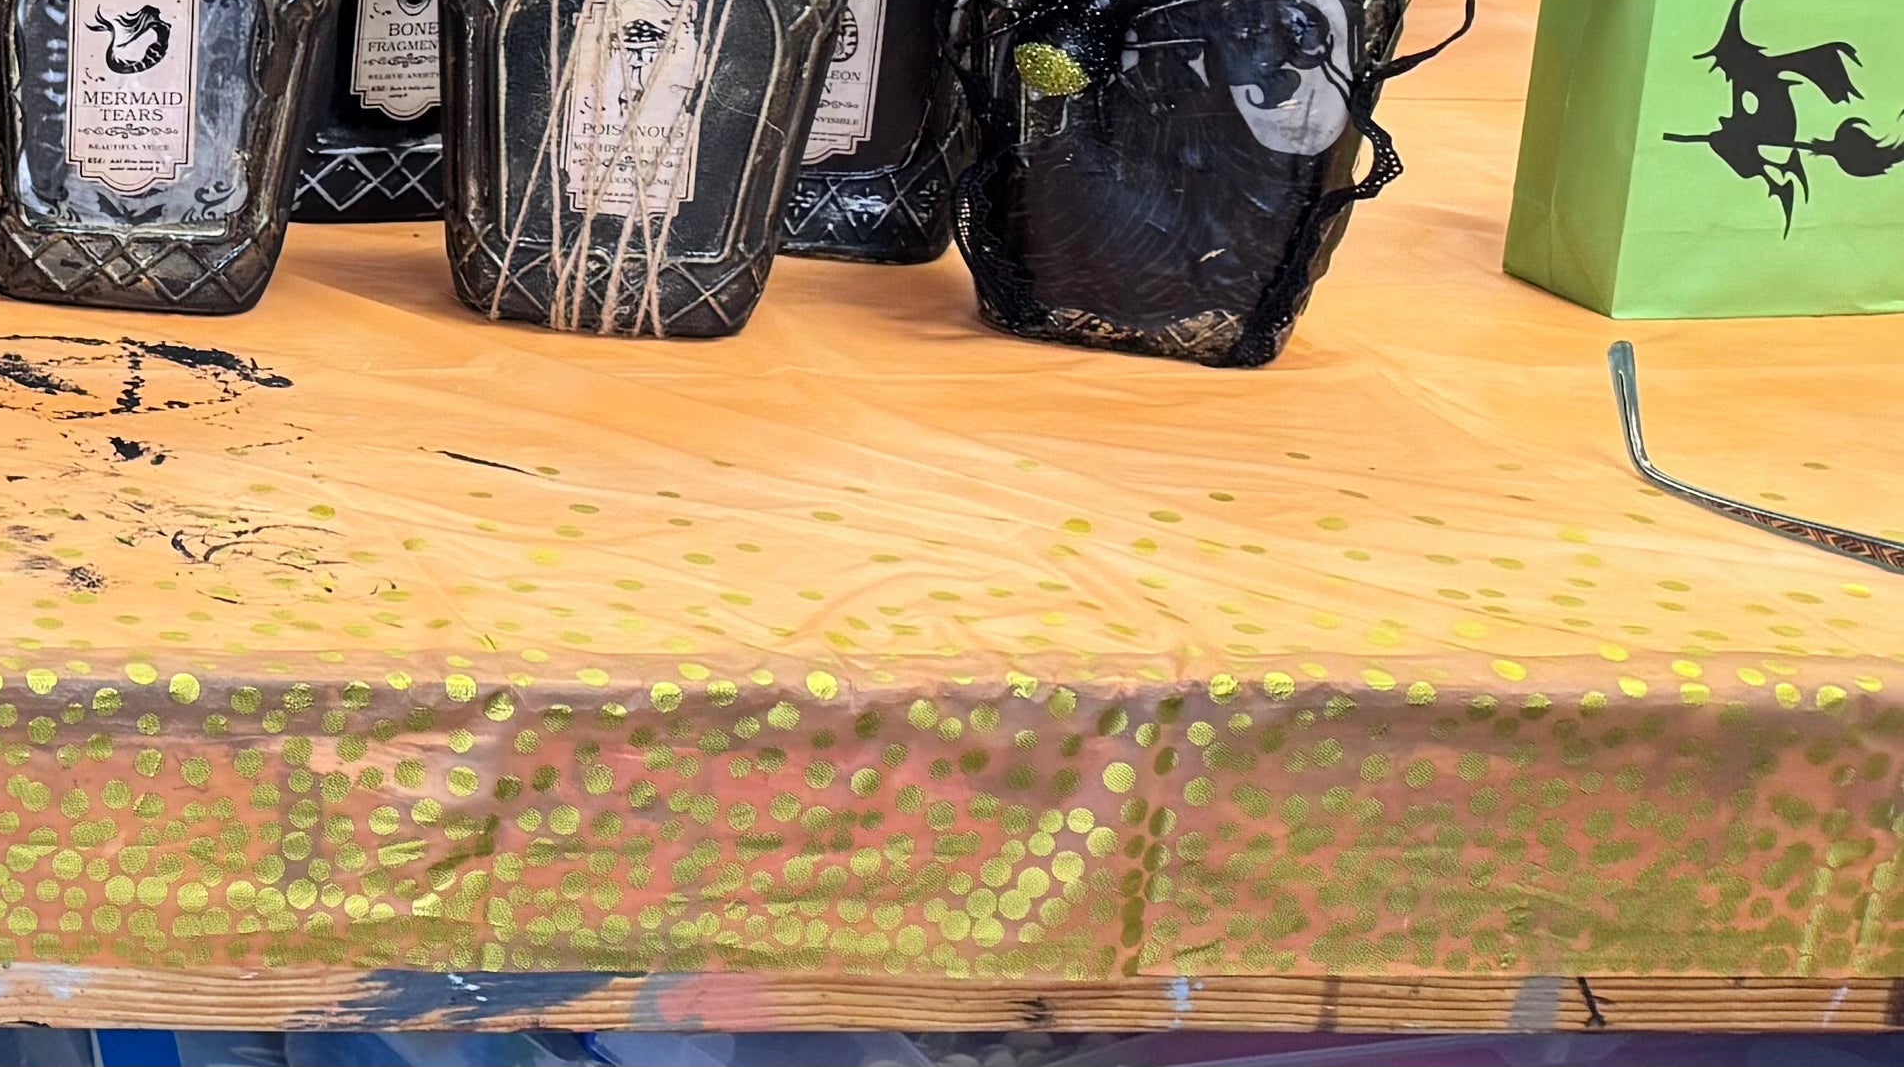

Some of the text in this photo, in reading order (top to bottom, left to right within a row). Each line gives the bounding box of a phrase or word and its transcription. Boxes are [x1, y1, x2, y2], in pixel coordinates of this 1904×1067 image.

[388, 22, 439, 36] BONE
[83, 90, 183, 105] MERMAID
[100, 108, 164, 121] TEARS
